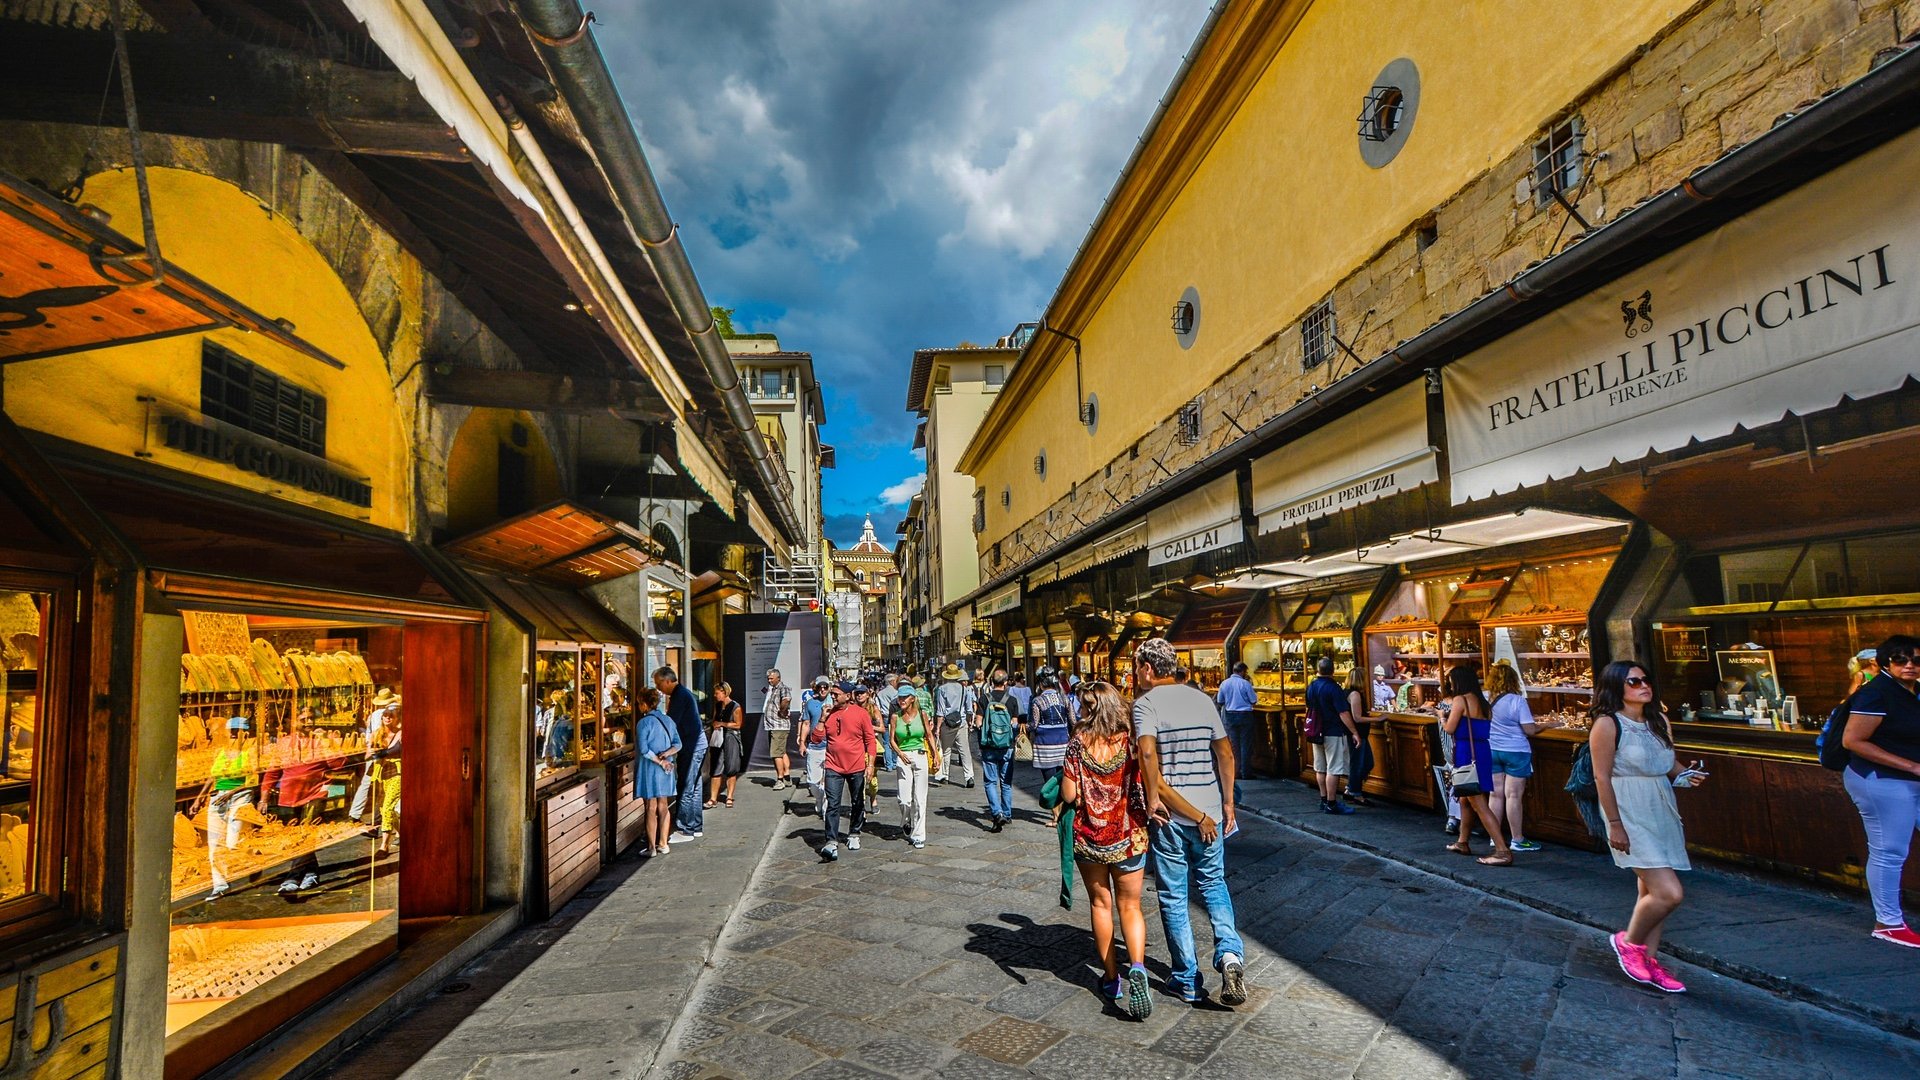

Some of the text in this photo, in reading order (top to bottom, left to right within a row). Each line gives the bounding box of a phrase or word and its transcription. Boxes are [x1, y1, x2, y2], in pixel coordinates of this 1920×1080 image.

[1487, 243, 1896, 431] FRATELLI PICCINI
[1608, 367, 1688, 407] FIRENZE
[165, 417, 372, 508] THE GOLDSMITH
[1282, 473, 1395, 521] FRATELLI PERUZZI
[1164, 529, 1219, 559] CALLAI
